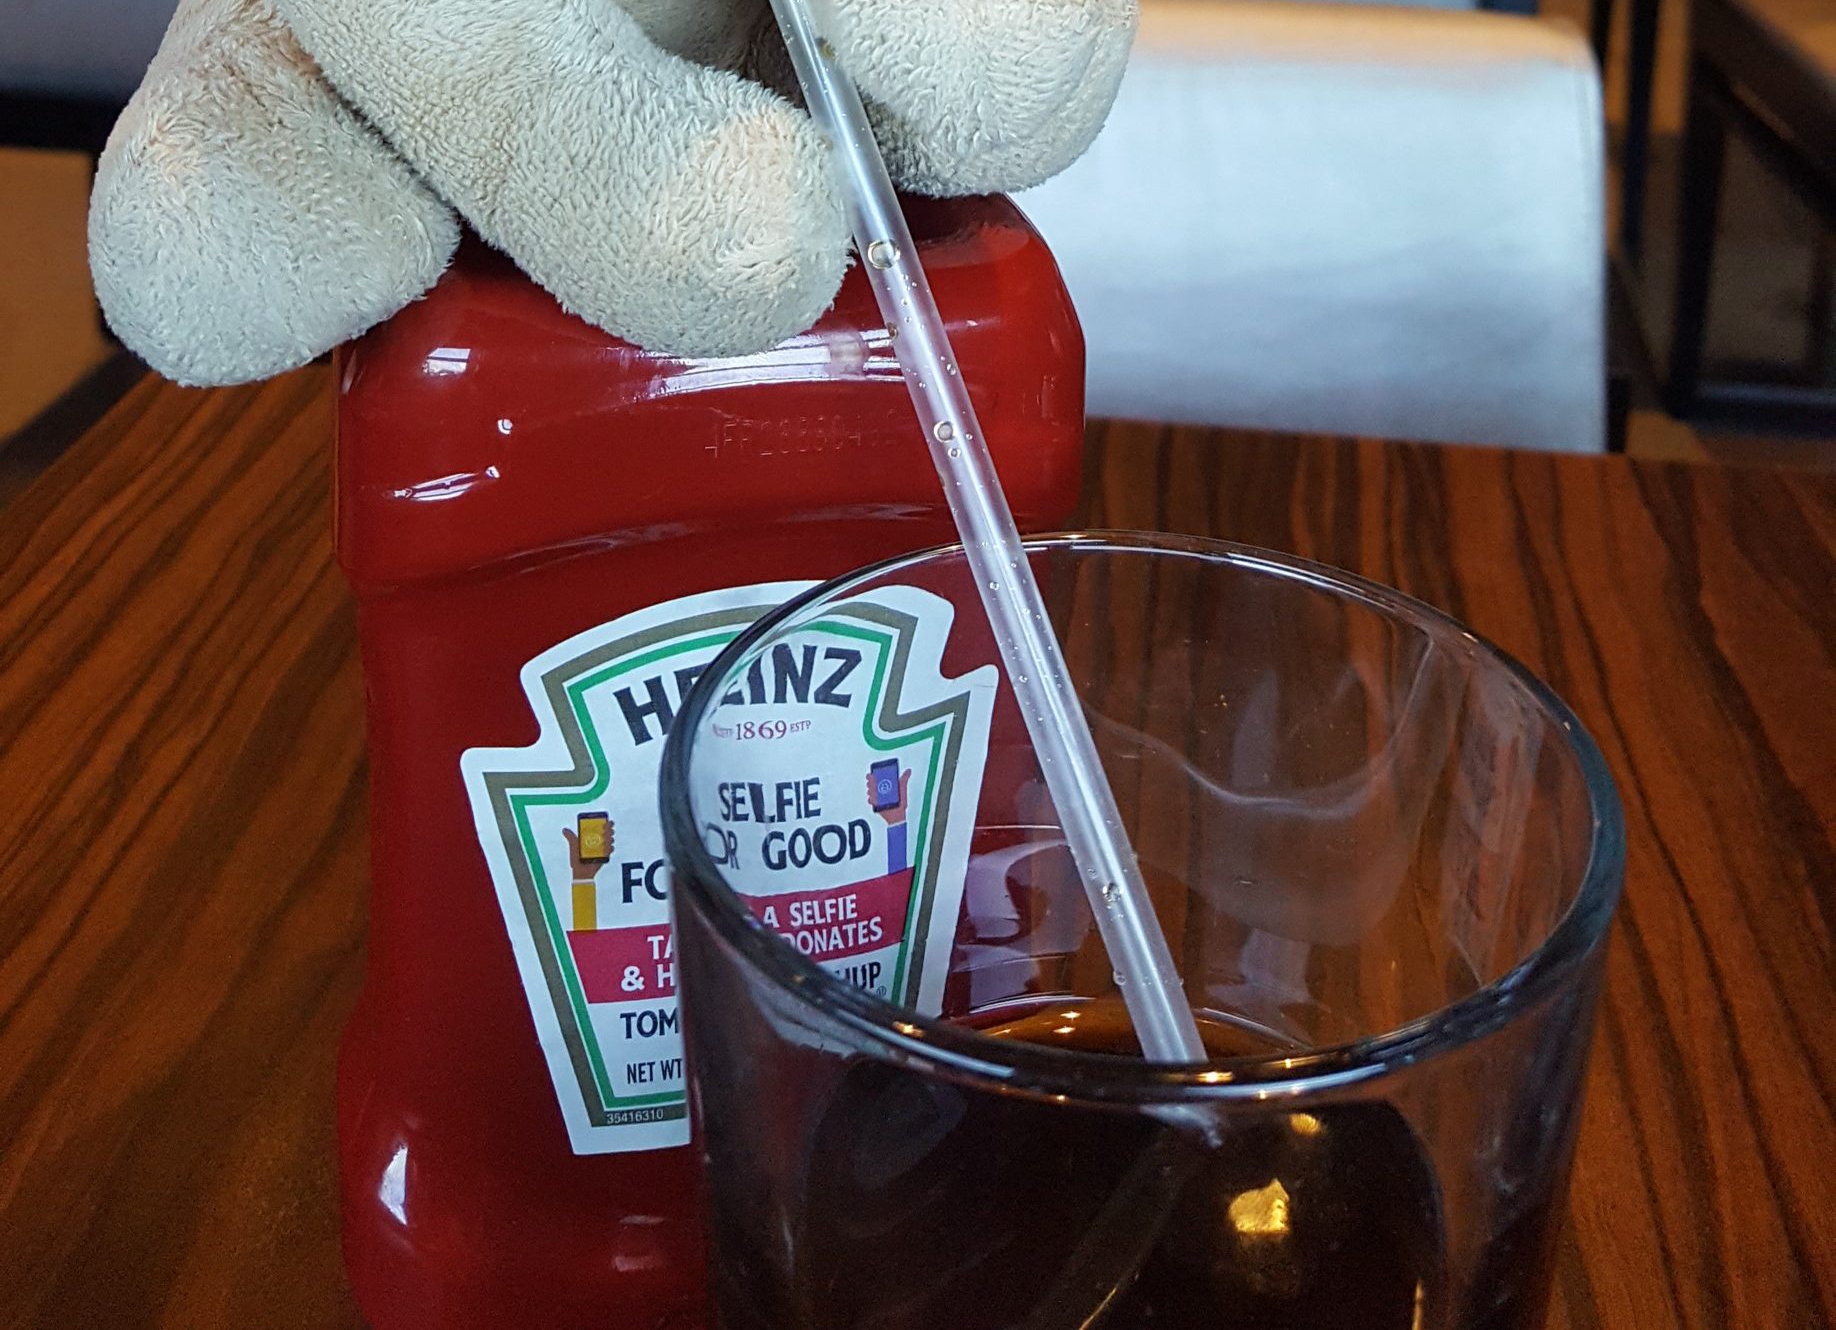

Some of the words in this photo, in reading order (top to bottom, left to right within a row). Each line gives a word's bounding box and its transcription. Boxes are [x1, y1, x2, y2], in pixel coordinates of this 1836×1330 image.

[613, 643, 862, 746] HEINZ
[736, 720, 787, 740] 1869
[718, 776, 821, 823] SELFIE
[761, 818, 872, 871] GOOD
[763, 906, 780, 928] A
[789, 893, 858, 928] SELFIE
[626, 1061, 656, 1085] NET
[660, 1058, 682, 1081] WT
[606, 1109, 664, 1125] 35416310
